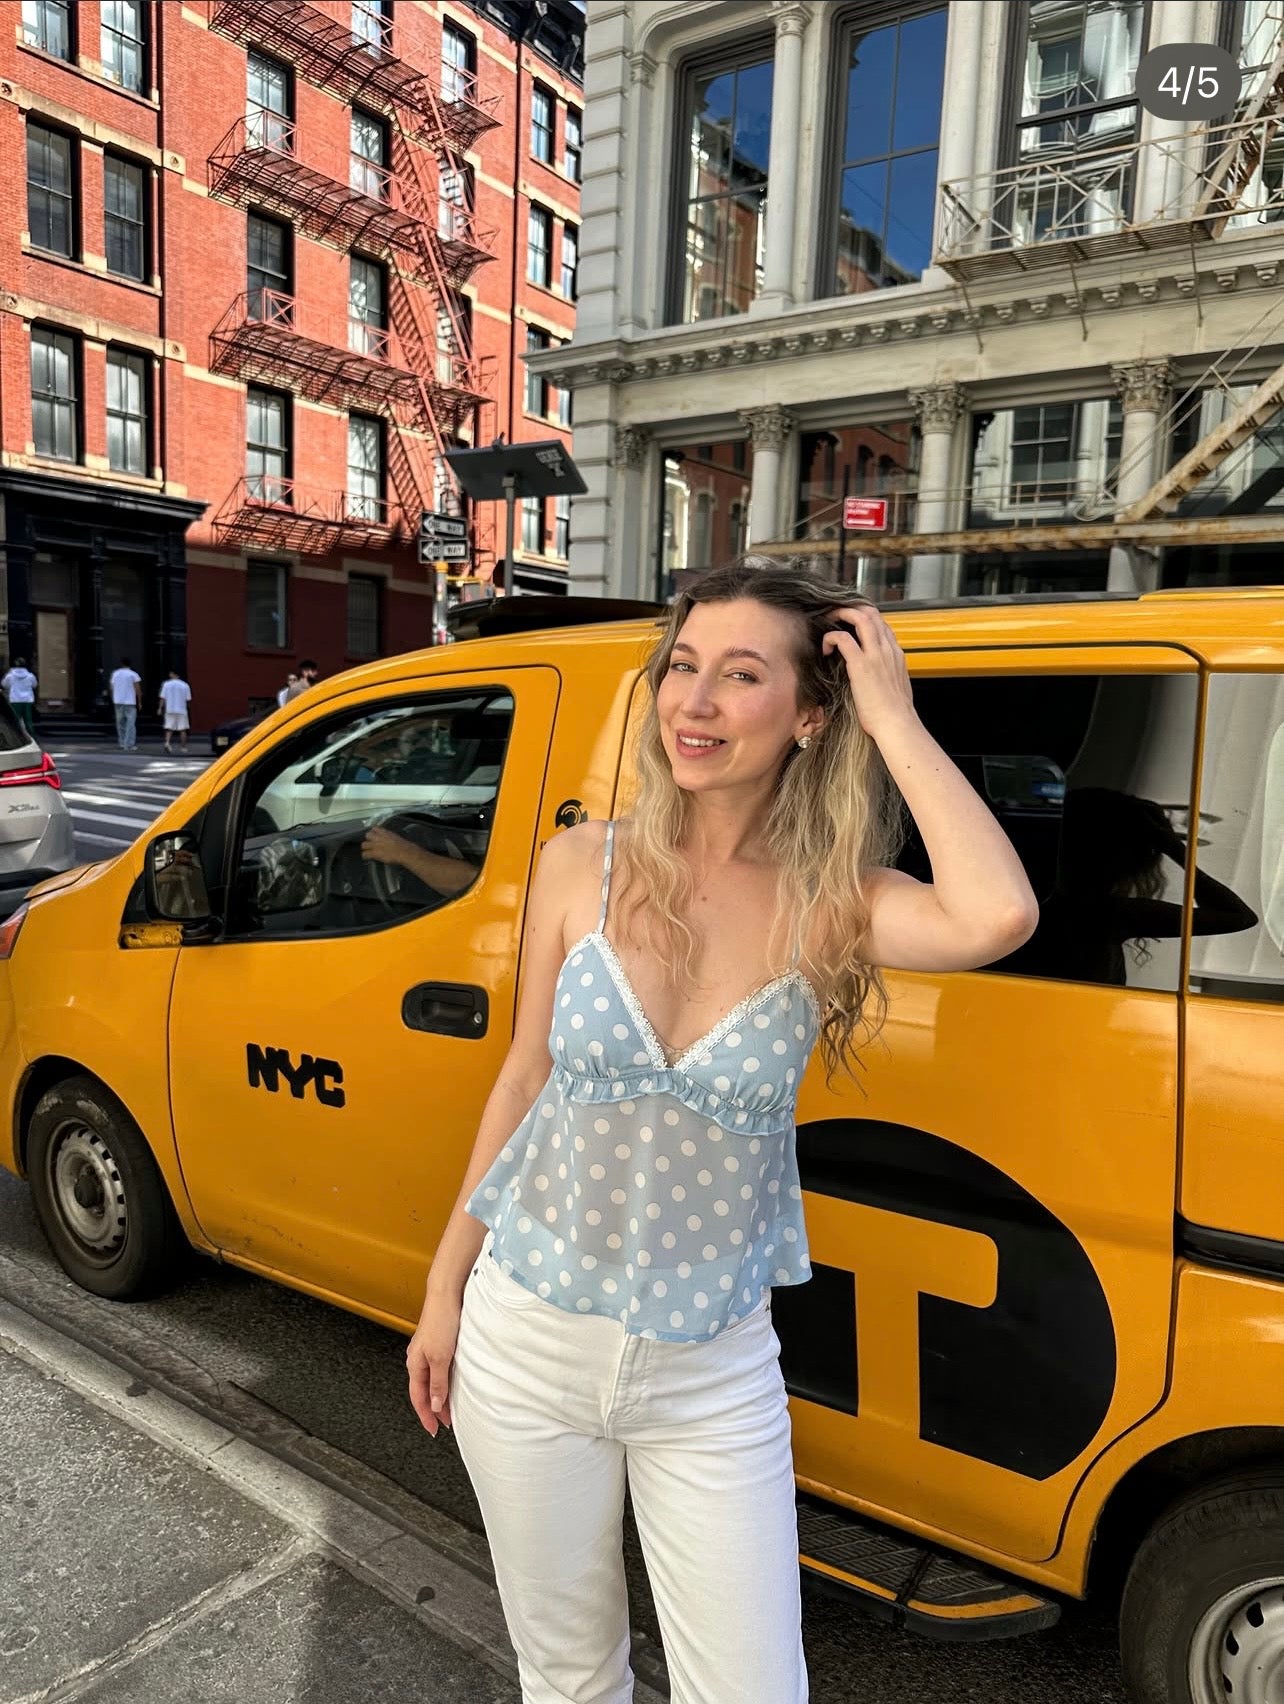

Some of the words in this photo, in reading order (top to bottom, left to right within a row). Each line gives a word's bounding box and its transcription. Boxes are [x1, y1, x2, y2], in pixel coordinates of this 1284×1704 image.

[428, 519, 440, 531] ONE
[447, 523, 462, 534] WAY
[428, 545, 440, 555] ONE
[447, 545, 463, 554] WAY
[246, 1042, 346, 1109] NYC
[798, 1190, 999, 1438] T
